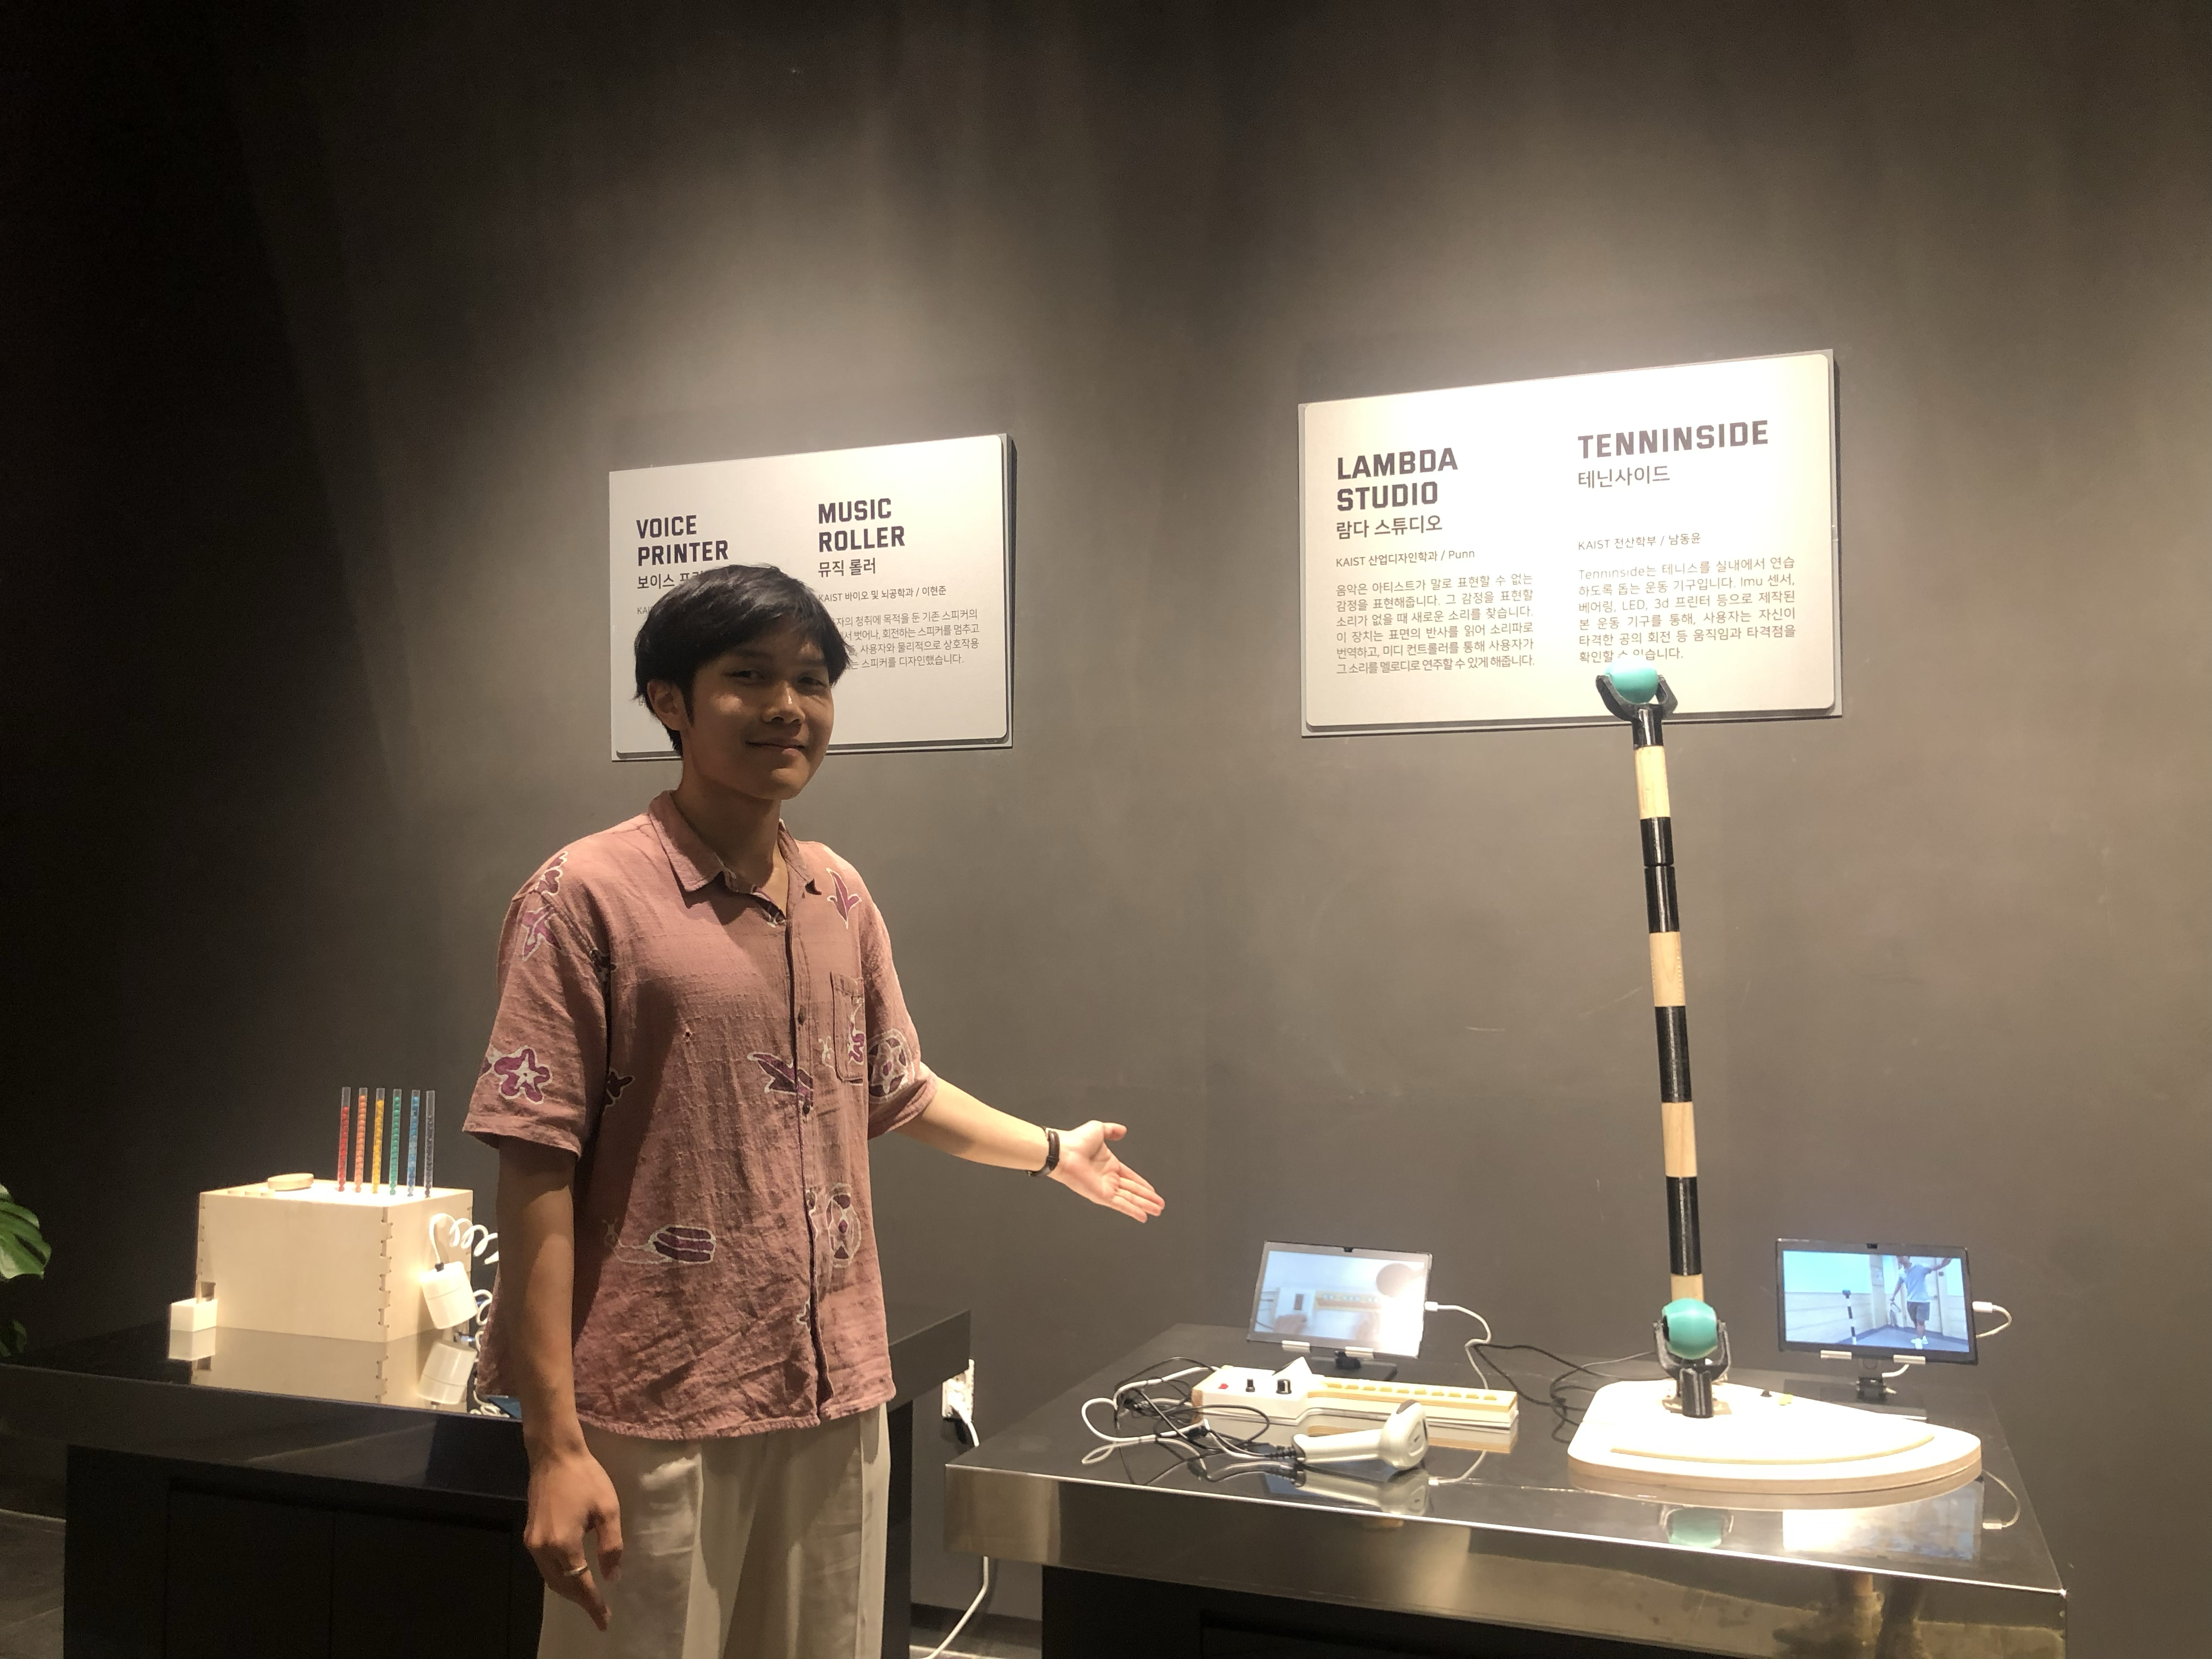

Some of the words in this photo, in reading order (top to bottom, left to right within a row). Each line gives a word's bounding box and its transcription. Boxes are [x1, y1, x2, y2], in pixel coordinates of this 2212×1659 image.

[1578, 420, 1768, 459] TENNINSIDE
[1338, 448, 1458, 480] LAMBDA
[1578, 466, 1670, 488] 테닌사이드
[1338, 482, 1437, 511] STUDIO
[819, 498, 891, 524] MUSIC
[636, 515, 697, 539] VOICE
[1337, 520, 1369, 539] 람다
[1374, 515, 1442, 535] 스튜디오
[819, 526, 905, 552] ROLLER
[1579, 540, 1610, 550] KAIST
[1615, 536, 1656, 549] 전산학부
[1669, 533, 1701, 545] 남동윤
[638, 540, 728, 566] PRINTER
[1336, 557, 1365, 567] KAIST
[1368, 551, 1437, 566] 산업디자인학과
[819, 560, 844, 577] 뮤직
[849, 557, 875, 575] 롤러
[1579, 566, 1656, 579] Tenninside는
[1662, 561, 1711, 575] 테니스를
[1716, 558, 1764, 572] 실내에서
[1770, 556, 1795, 569] 연습
[637, 574, 675, 589] 보이스
[1336, 584, 1368, 596] 음악은
[1373, 579, 1426, 594] 아티스트가
[1431, 579, 1452, 590] 말로
[1458, 575, 1490, 588] 표현할
[1496, 575, 1505, 586] 수
[1511, 573, 1532, 585] 없는
[1579, 584, 1612, 597] 하도록
[1618, 583, 1640, 595] 돕는
[1645, 581, 1668, 593] 운동
[1674, 577, 1735, 591] 기구입니다.
[1741, 577, 1762, 586] Imu
[1768, 573, 1794, 586] 센서,
[818, 592, 843, 603] KAIST
[845, 591, 868, 601] 바이오
[871, 590, 878, 600] 및
[882, 588, 913, 599] 뇌공학과
[922, 586, 946, 596] 이현준
[1337, 599, 1368, 612] 감정을
[1373, 595, 1440, 609] 표현해줍니다.
[1446, 595, 1455, 604] 그
[1462, 591, 1494, 605] 감정을
[1500, 589, 1533, 601] 표현할
[1579, 601, 1616, 613] 베어링,
[1623, 600, 1647, 611] LED,
[1655, 598, 1668, 608] 3d
[1675, 595, 1709, 608] 프린터
[1717, 593, 1752, 606] 등으로
[1759, 590, 1795, 603] 제작된
[856, 615, 881, 627] 청취에
[883, 613, 909, 624] 목적을
[912, 613, 920, 623] 둔
[923, 611, 940, 622] 기존
[942, 609, 977, 620] 스피커의
[1336, 615, 1368, 627] 소리가
[1372, 613, 1393, 626] 없을
[1397, 613, 1407, 624] 때
[1412, 611, 1444, 623] 새로운
[1448, 608, 1481, 620] 소리를
[1486, 606, 1533, 619] 찾습니다.
[1579, 619, 1589, 630] 본
[1598, 617, 1620, 629] 운동
[1628, 615, 1662, 627] 기구를
[1669, 613, 1695, 626] 통해,
[1703, 611, 1751, 623] 사용자는
[1759, 607, 1795, 620] 자신이
[854, 629, 880, 640] 벗어나,
[883, 628, 916, 639] 회전하는
[918, 625, 951, 636] 스피커를
[954, 624, 979, 635] 멈추고
[1337, 632, 1346, 643] 이
[1352, 630, 1383, 643] 장치는
[1389, 628, 1420, 640] 표면의
[1426, 626, 1458, 637] 반사를
[1464, 624, 1485, 636] 읽어
[1490, 623, 1533, 634] 소리파로
[1579, 634, 1613, 646] 타격한
[1620, 633, 1641, 645] 공의
[1648, 631, 1670, 643] 회전
[1677, 630, 1688, 642] 등
[1694, 628, 1741, 641] 움직임과
[1747, 625, 1796, 638] 타격점을
[861, 643, 895, 654] 사용자와
[898, 641, 941, 653] 물리적으로
[944, 638, 979, 650] 상호작용
[1337, 647, 1379, 659] 번역하고,
[1383, 645, 1403, 656] 미디
[1407, 642, 1459, 656] 컨트롤러를
[1463, 640, 1485, 653] 통해
[1489, 638, 1533, 651] 사용자가
[1579, 650, 1614, 663] 확인할
[862, 657, 896, 668] 스피커를
[900, 653, 964, 667] 디자인했습니다.
[1336, 664, 1347, 674] 그
[1348, 662, 1378, 674] 소리를
[1380, 661, 1420, 673] 멜로디로
[1423, 658, 1453, 671] 연주할
[1455, 658, 1465, 669] 수
[1468, 657, 1488, 668] 있게
[1491, 654, 1534, 667] 해줍니다.
